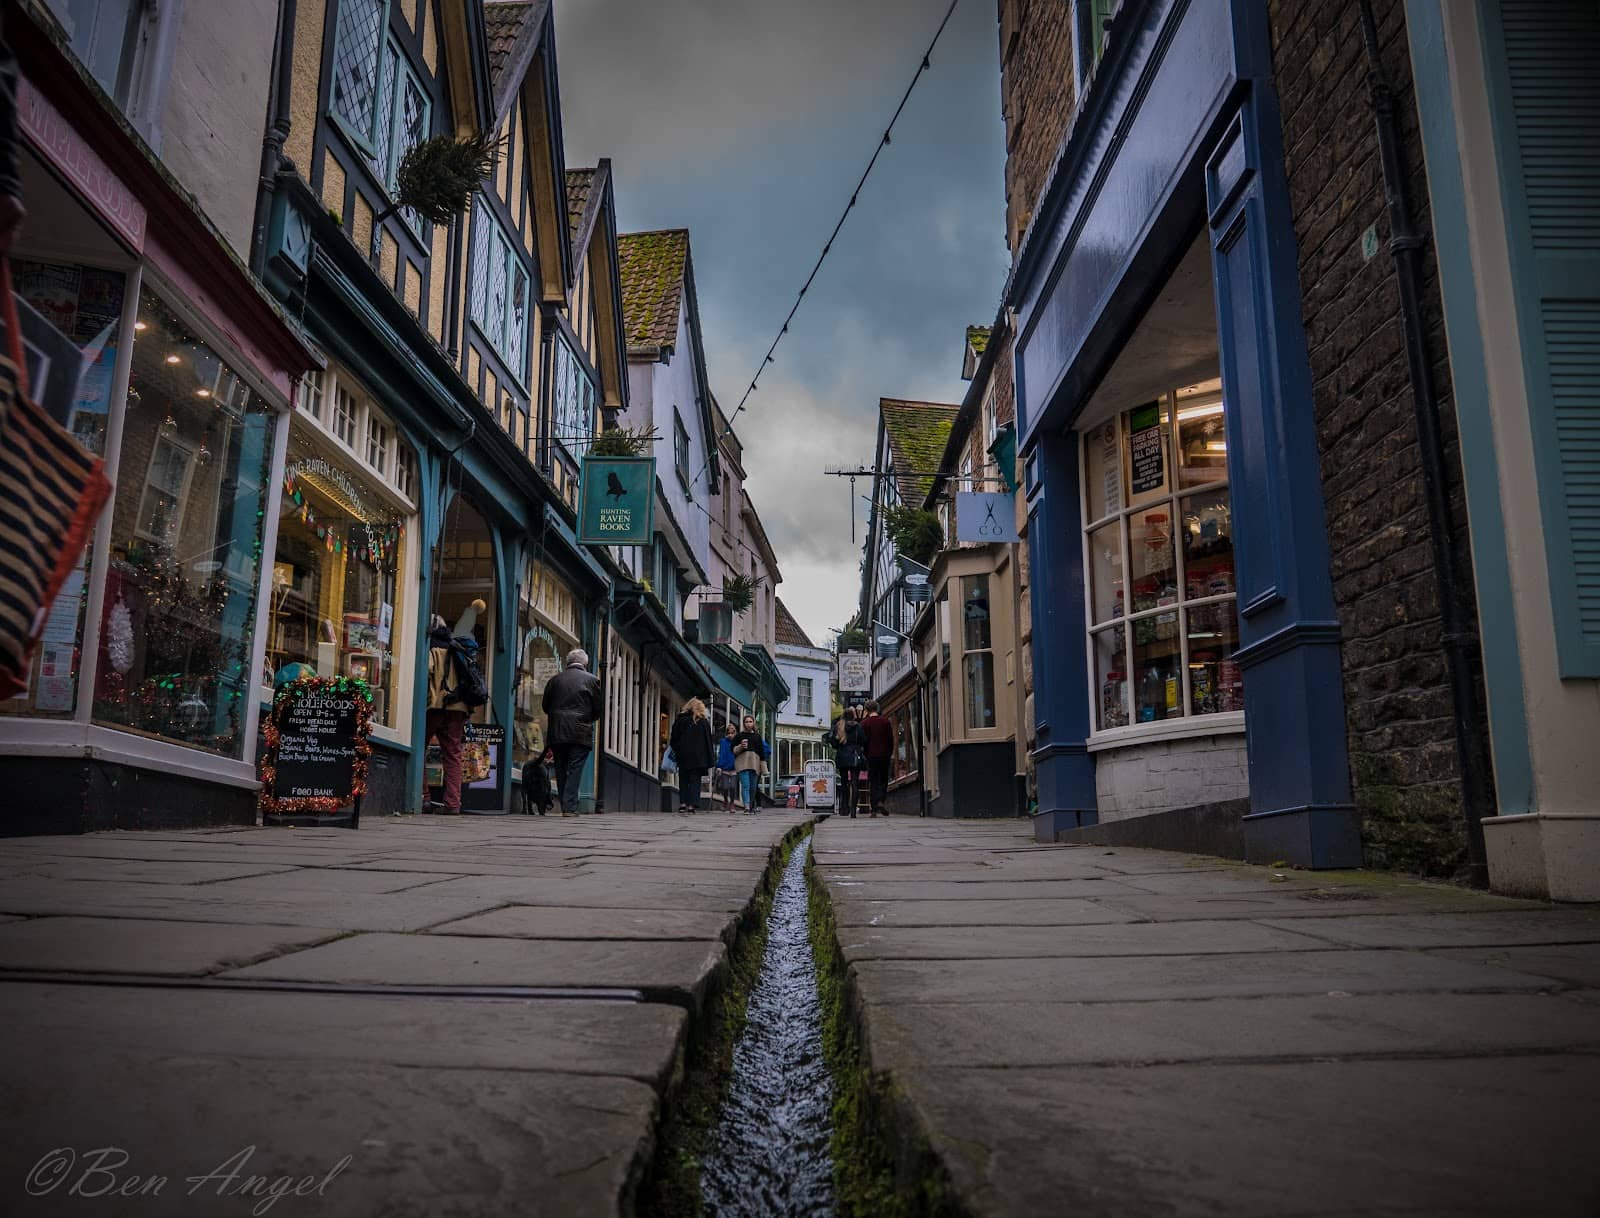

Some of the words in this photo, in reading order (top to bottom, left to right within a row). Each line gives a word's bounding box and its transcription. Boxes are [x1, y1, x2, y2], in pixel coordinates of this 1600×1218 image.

[1145, 446, 1159, 457] DAY
[306, 458, 330, 476] RAVEN
[600, 515, 631, 523] RAVEN
[600, 523, 631, 531] BOOKS
[293, 708, 313, 717] OPEN
[288, 717, 306, 725] FRESH
[280, 734, 306, 746] Organic
[292, 787, 312, 796] FOOD
[313, 788, 335, 797] BANK
